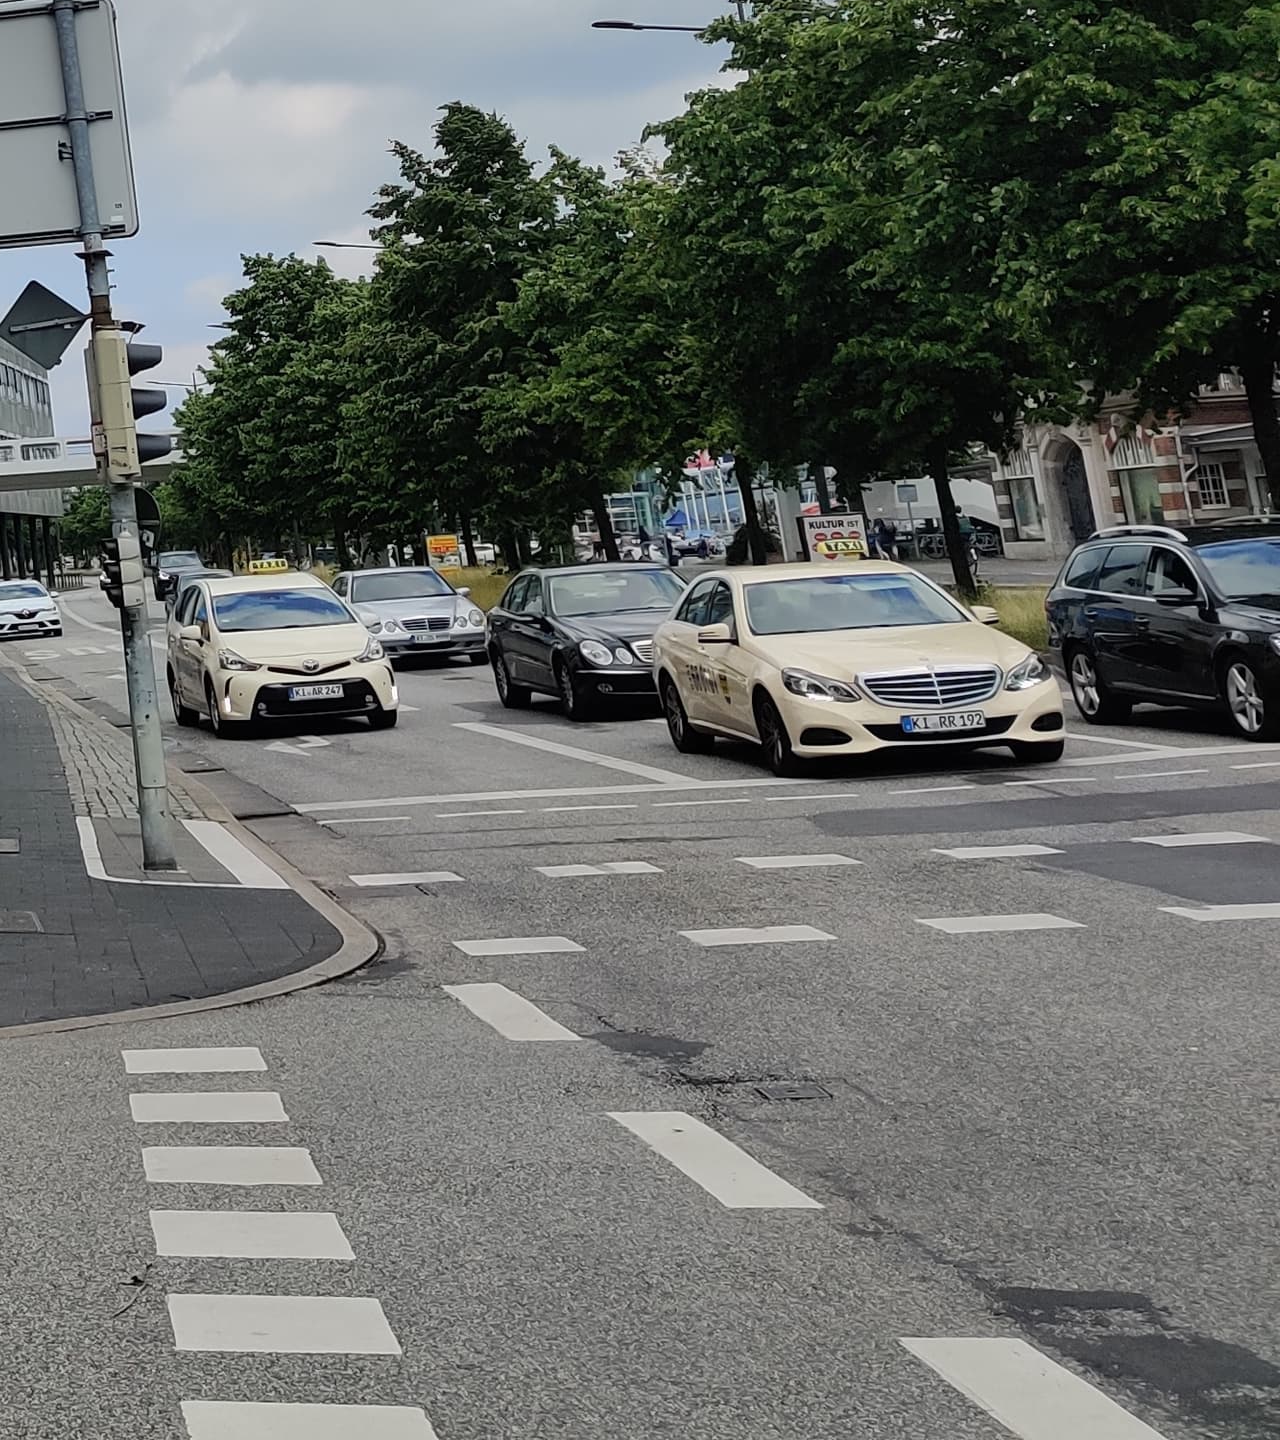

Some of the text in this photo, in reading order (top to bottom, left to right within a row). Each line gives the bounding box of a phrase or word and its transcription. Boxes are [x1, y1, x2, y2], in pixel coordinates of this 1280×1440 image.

[808, 519, 859, 530] KULTUR IST
[827, 540, 861, 552] TAXI
[312, 686, 324, 697] AR
[325, 685, 341, 696] 247
[911, 713, 984, 730] KI RR 192
